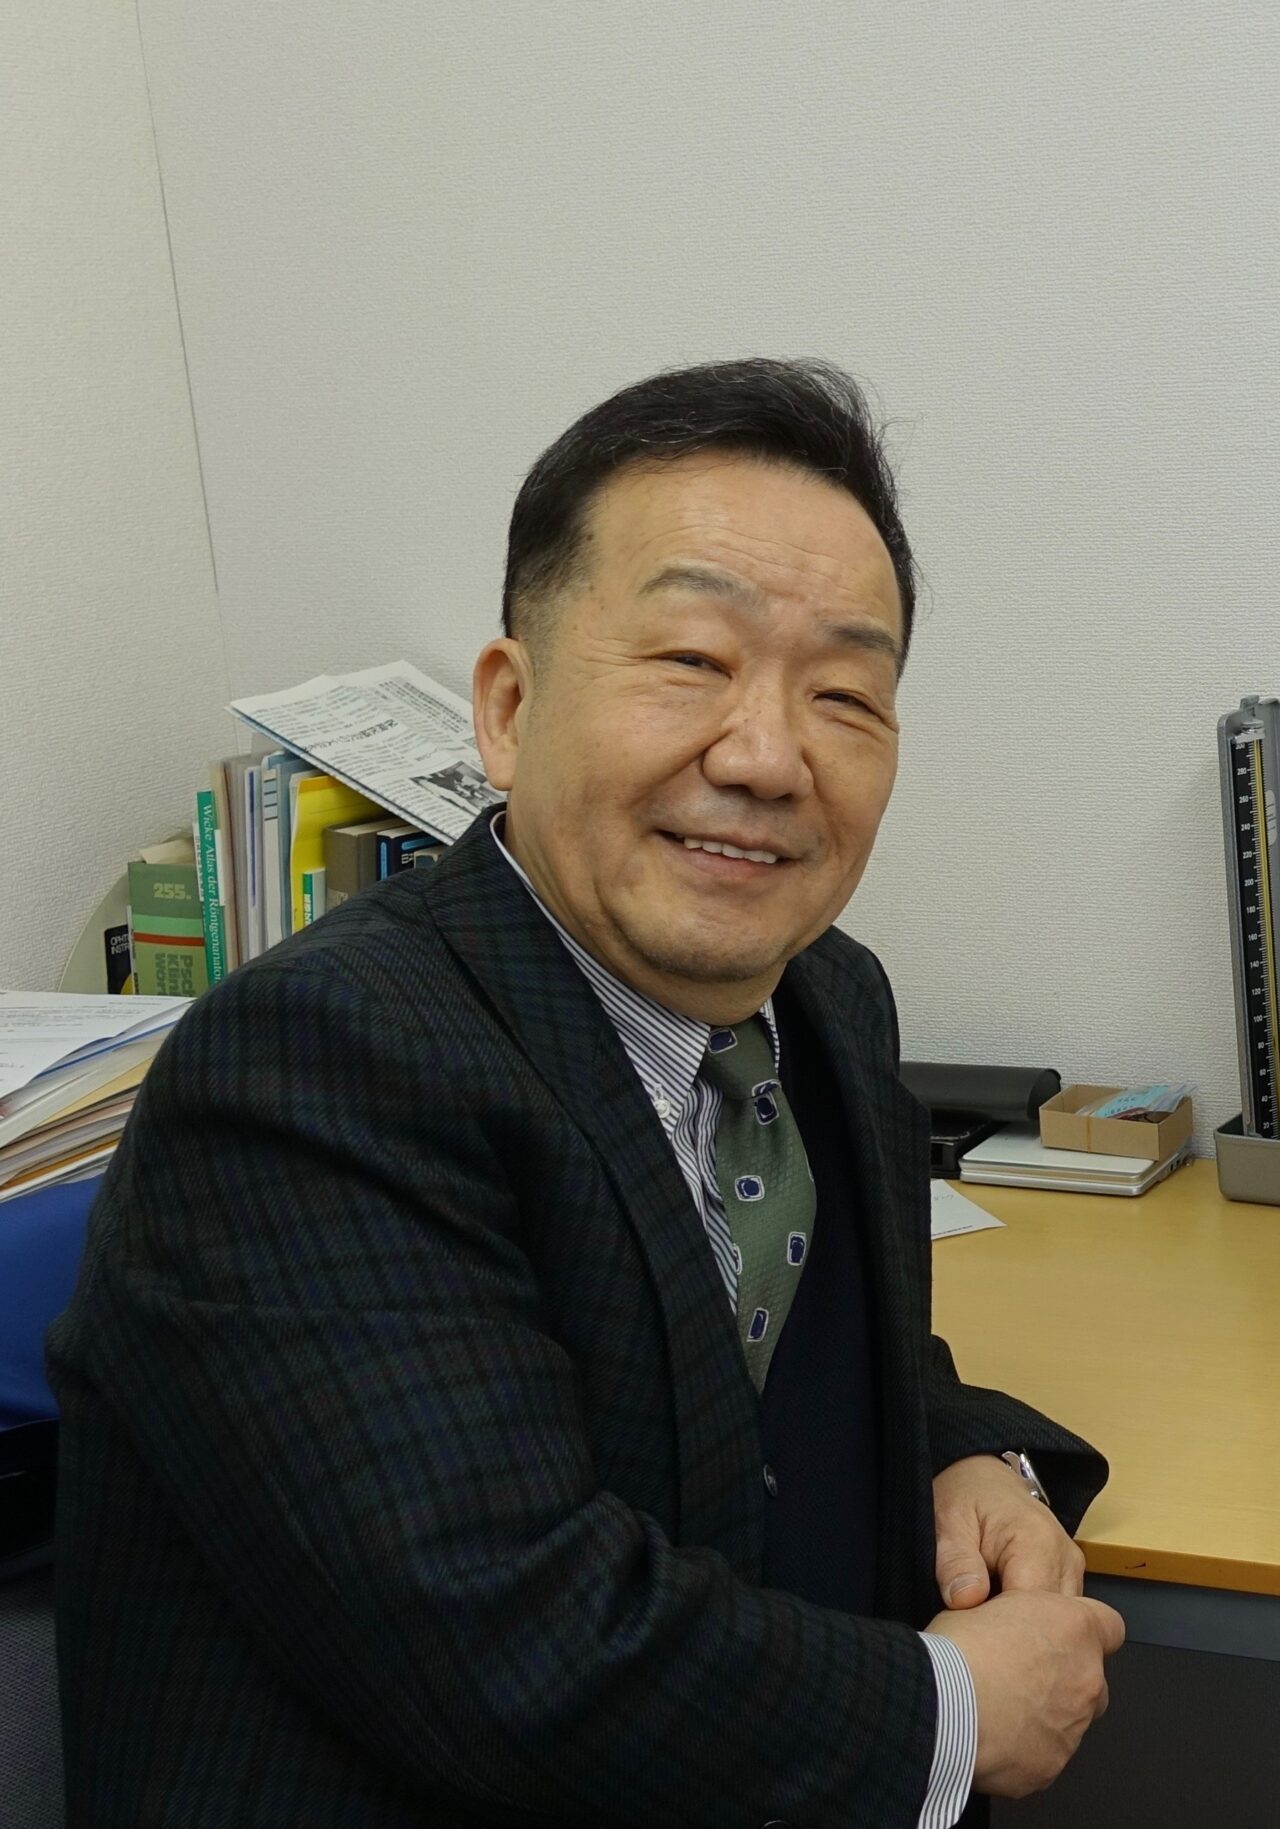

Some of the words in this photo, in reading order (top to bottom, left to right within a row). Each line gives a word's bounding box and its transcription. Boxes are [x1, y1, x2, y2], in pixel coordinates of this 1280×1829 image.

[203, 804, 214, 841] Wicke
[1241, 823, 1251, 832] 240
[206, 844, 215, 874] Atlas
[1242, 851, 1253, 860] 220
[208, 875, 217, 896] der
[1244, 878, 1254, 887] 200
[153, 882, 192, 900] 255.
[1246, 906, 1256, 914] 180
[1248, 933, 1258, 941] 160
[1249, 961, 1259, 969] 140
[1251, 988, 1261, 996] 120
[1253, 1014, 1263, 1023] 100
[1257, 1041, 1265, 1050] 80
